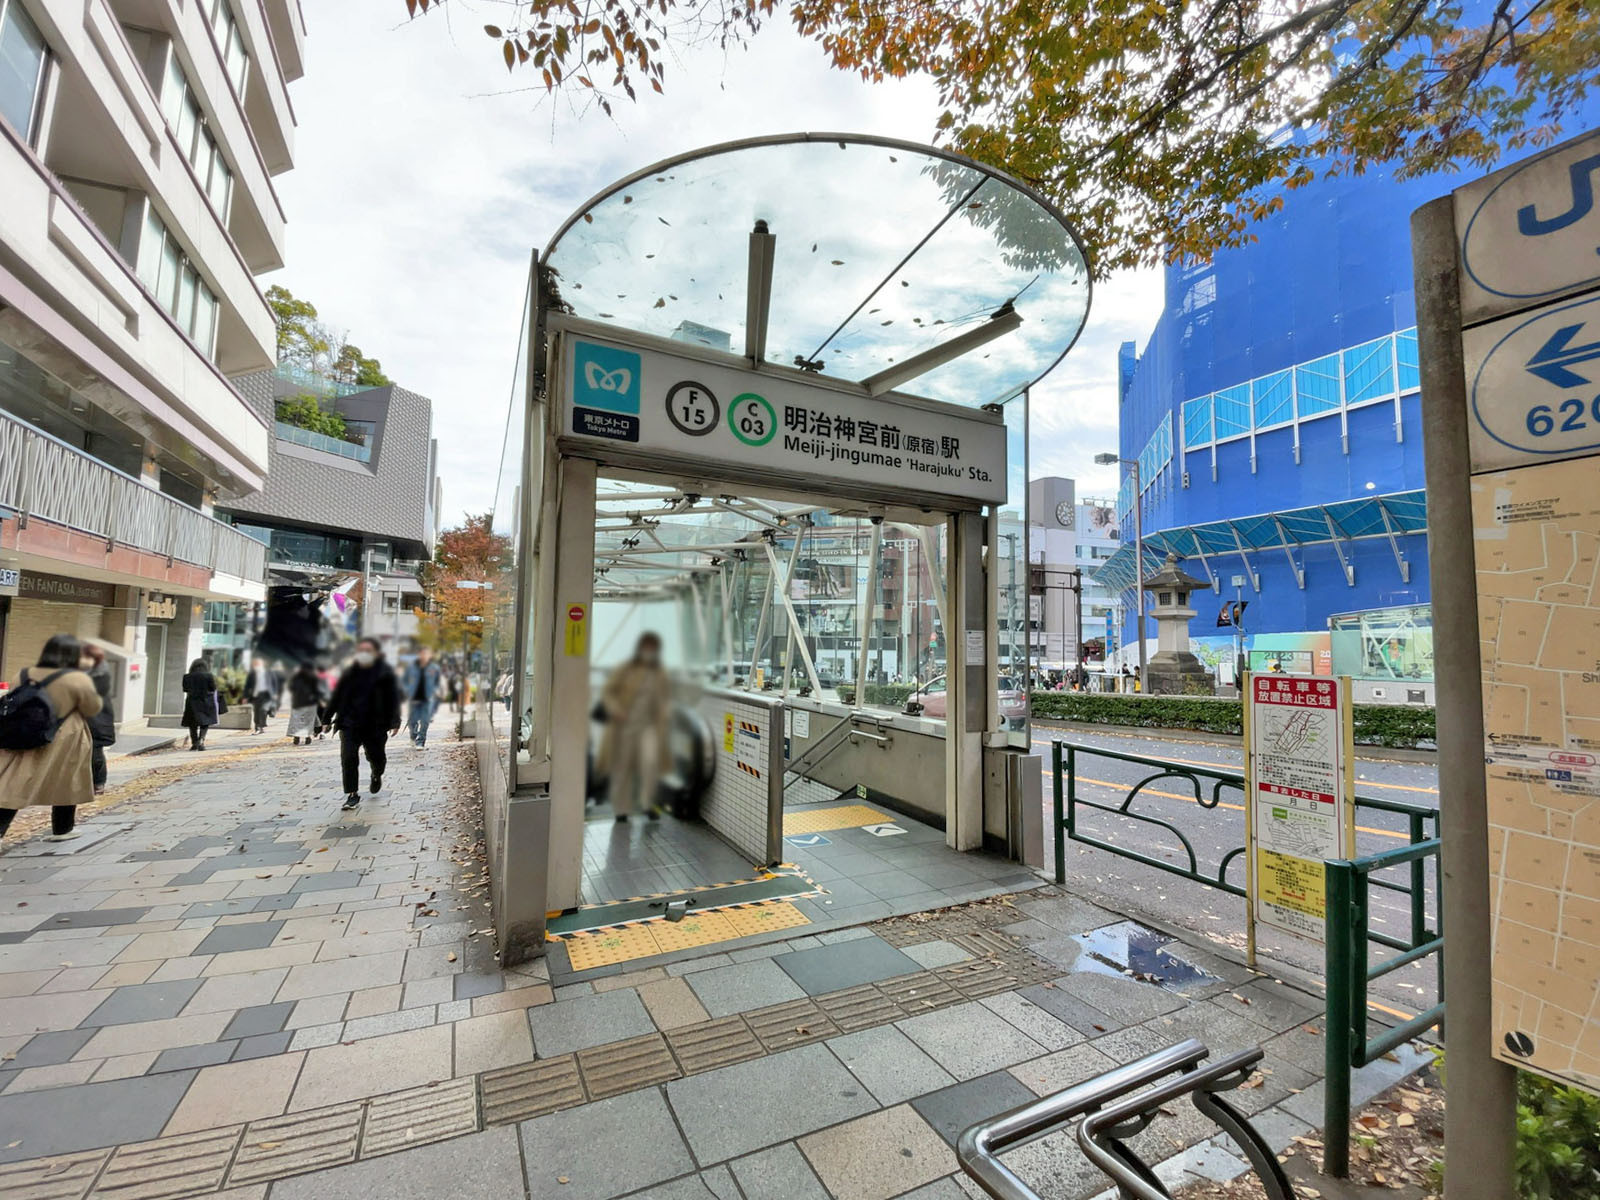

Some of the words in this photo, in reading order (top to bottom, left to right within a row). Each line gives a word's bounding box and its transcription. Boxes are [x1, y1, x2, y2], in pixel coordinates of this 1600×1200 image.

[689, 390, 698, 405] F
[682, 407, 706, 425] 15
[747, 402, 758, 417] C
[584, 413, 630, 429] 東京メトロ
[740, 417, 764, 436] 03
[587, 423, 606, 433] Tokyo
[607, 427, 627, 436] Metro
[784, 435, 902, 468] Meiji-jingumae
[906, 458, 965, 478] 'Harajuku'
[968, 466, 993, 482] Sta.
[0, 568, 18, 586] ART
[37, 578, 76, 595] FANTASIA
[1582, 672, 1600, 683] Sh
[1258, 680, 1331, 694] 自転車等
[1258, 691, 1331, 707] 放置禁止区域
[1289, 798, 1298, 807] 月
[1309, 802, 1318, 811] 日
